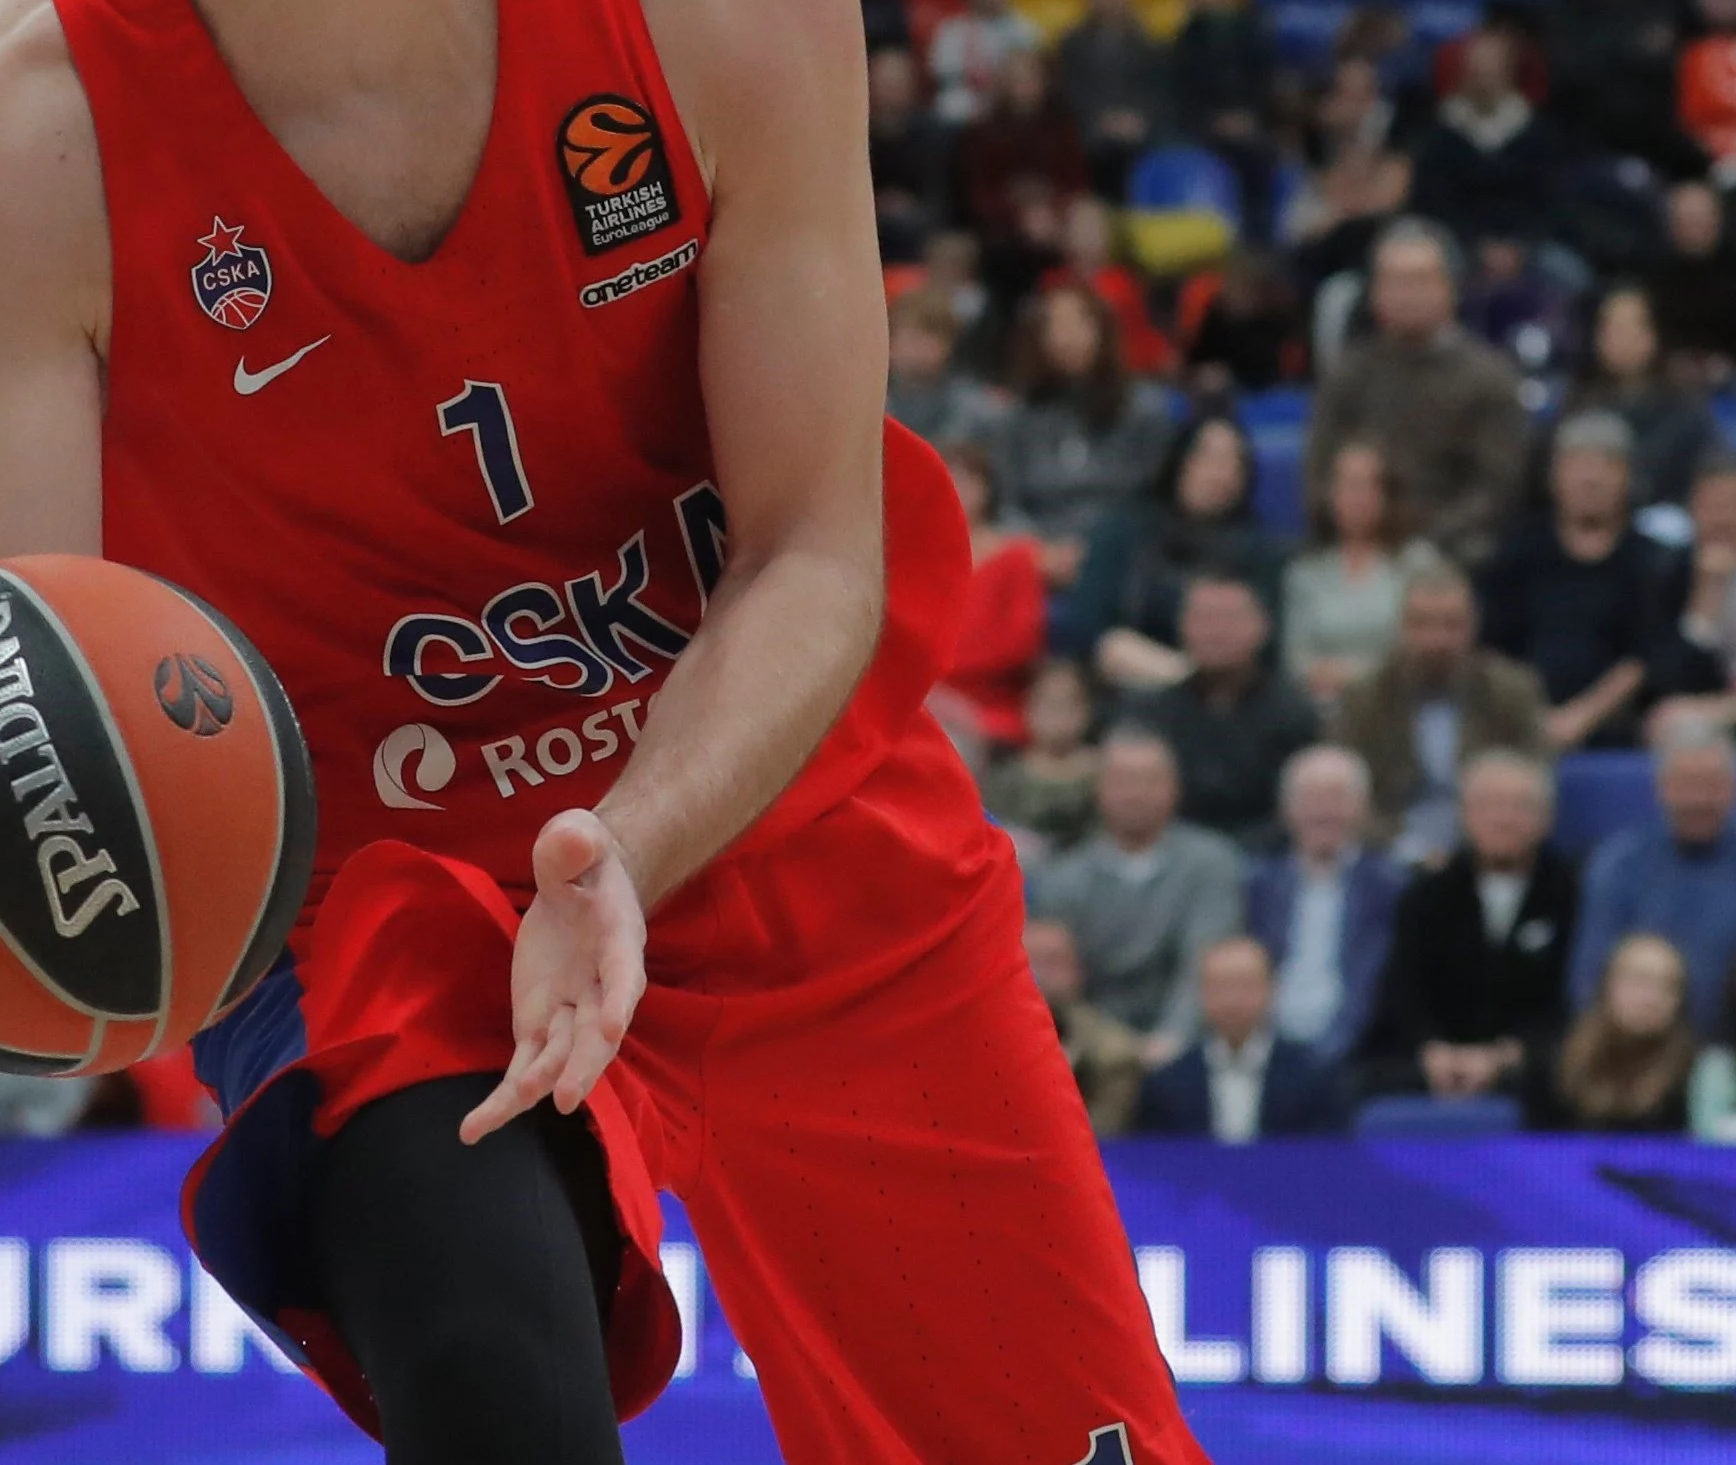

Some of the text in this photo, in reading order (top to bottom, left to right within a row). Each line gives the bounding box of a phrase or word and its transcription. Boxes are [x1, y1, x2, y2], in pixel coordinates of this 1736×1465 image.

[585, 181, 664, 219] TURKISH
[591, 196, 667, 233] AIRLINES
[592, 212, 670, 246] EuroLeague
[203, 260, 260, 291] CSKA
[436, 378, 535, 526] 1
[480, 693, 660, 799] ROST
